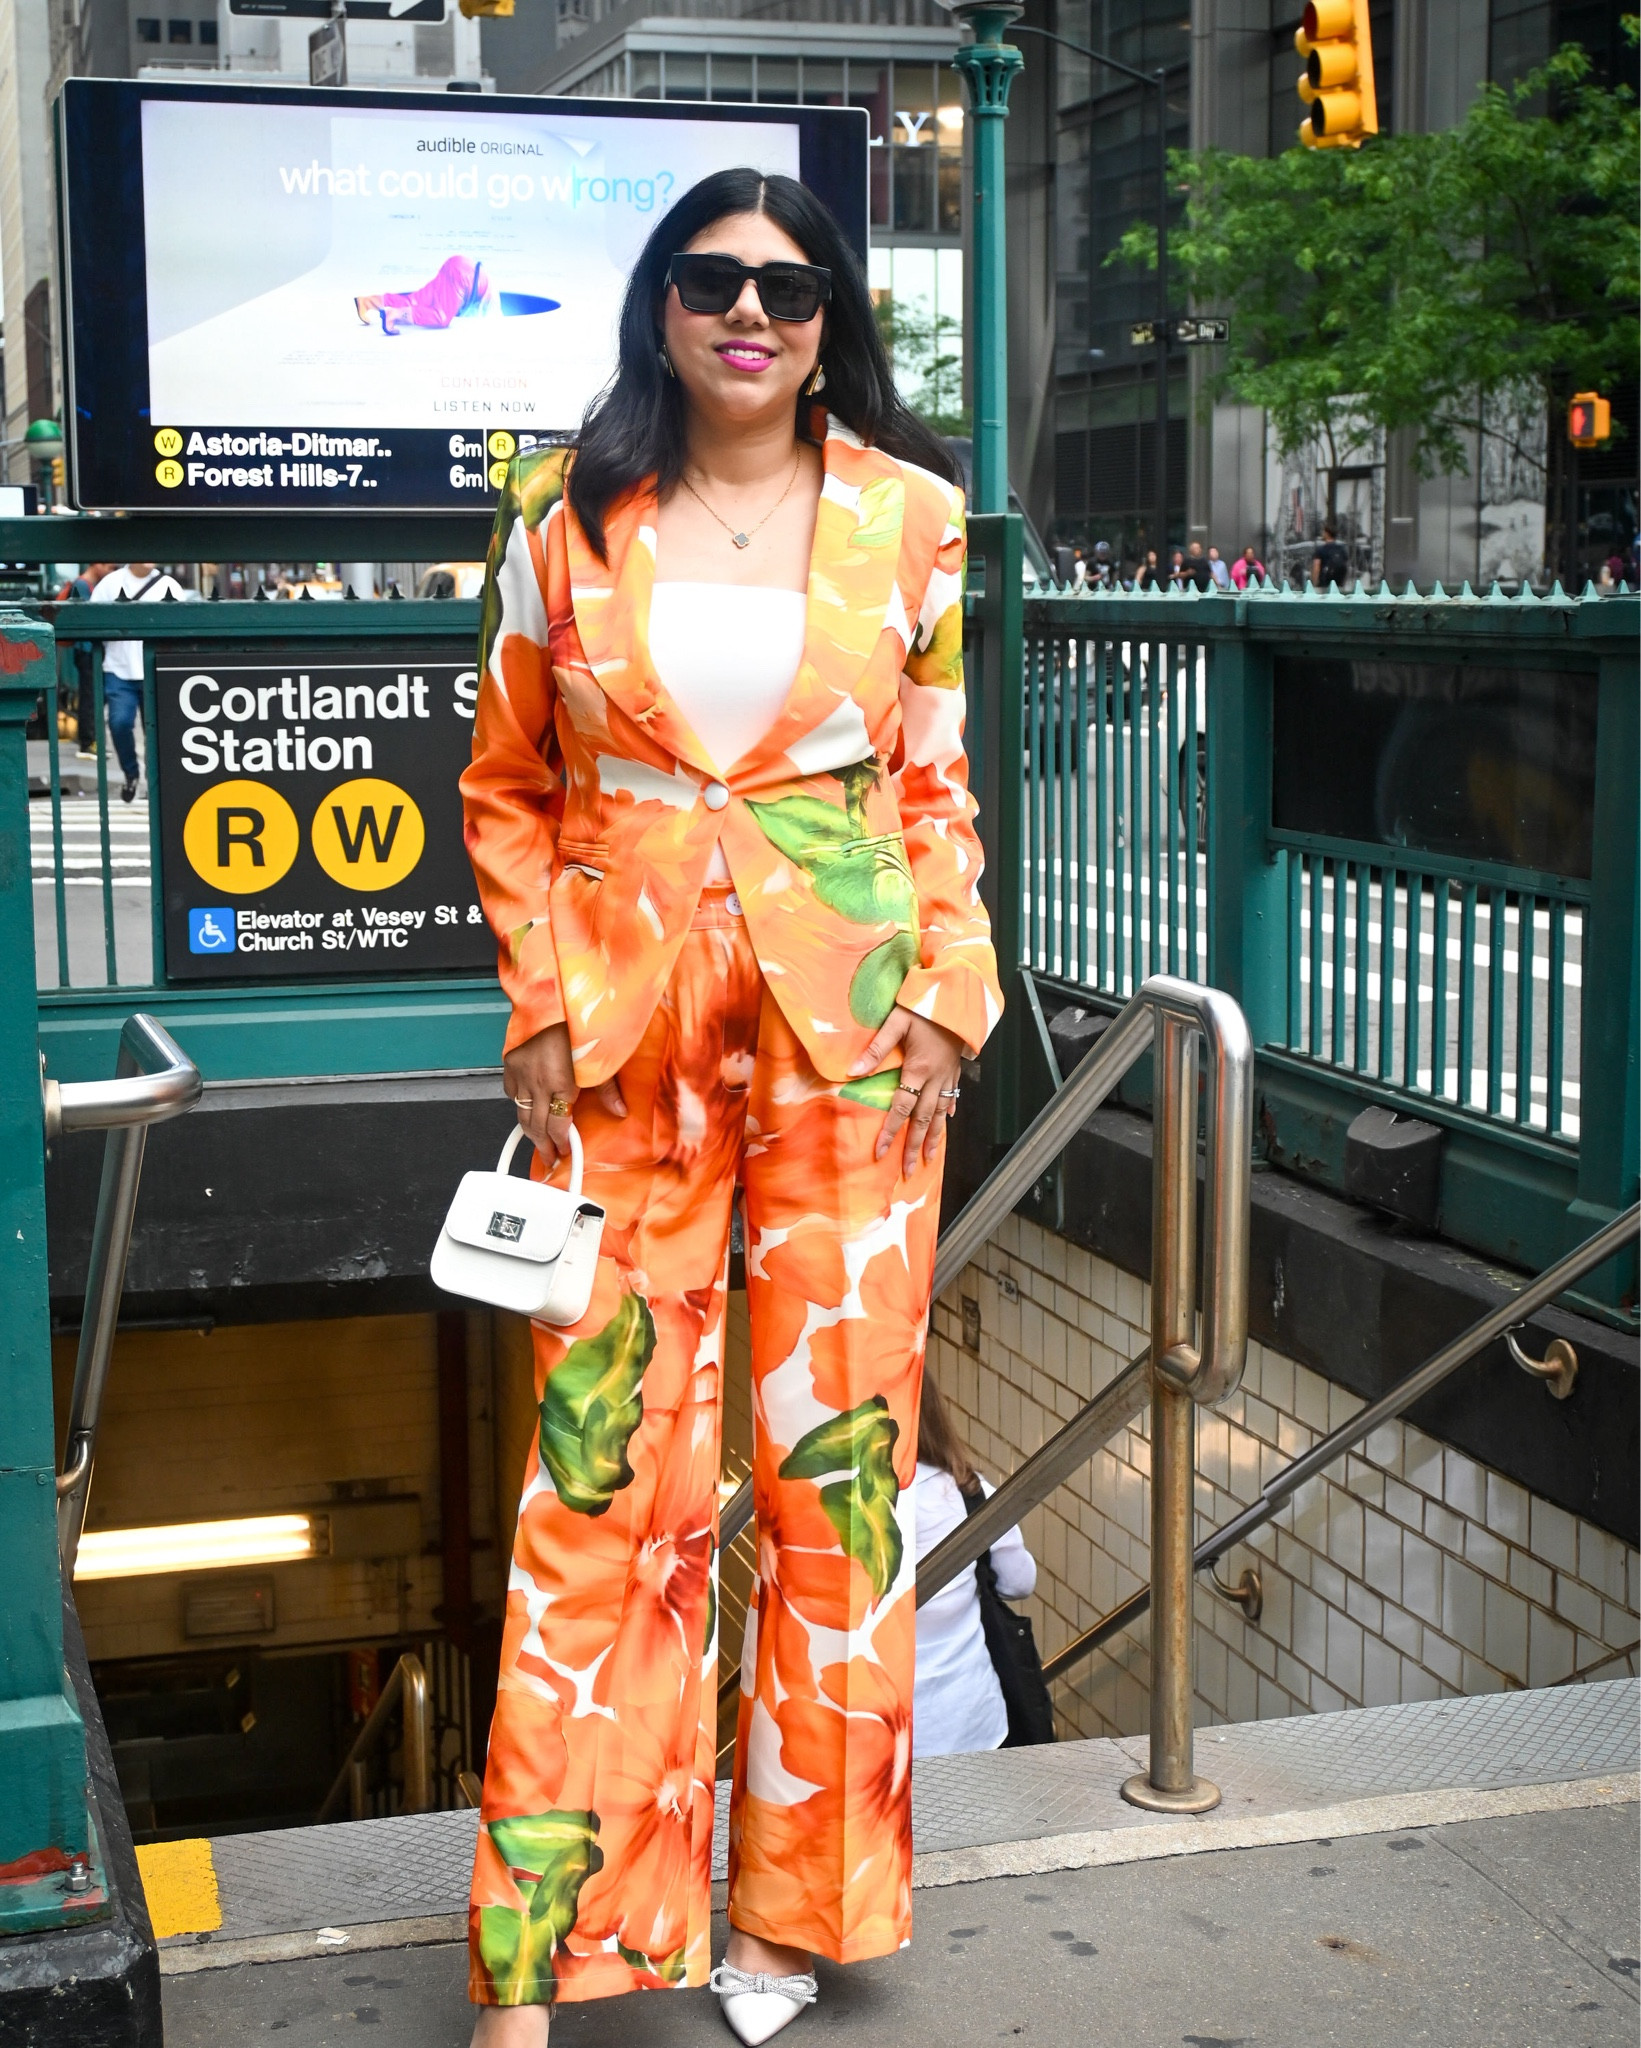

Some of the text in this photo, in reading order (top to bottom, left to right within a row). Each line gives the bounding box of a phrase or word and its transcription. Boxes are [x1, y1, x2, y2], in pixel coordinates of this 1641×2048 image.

[416, 137, 544, 156] audible ORIGINAL
[279, 159, 676, 213] what could go wrong?
[440, 376, 528, 389] CONTAGION
[433, 400, 536, 413] LISTEN NOW
[161, 431, 177, 449] W
[448, 434, 482, 458] 6m
[496, 438, 506, 451] R
[164, 466, 175, 480] R
[187, 462, 274, 487] Forest
[449, 464, 484, 488] 6m
[178, 673, 430, 723] Cortlandt
[181, 726, 373, 774] Station
[216, 804, 405, 867] R W
[236, 904, 483, 930] Elevator at Vesey St &
[237, 928, 409, 952] Church St/WTC
